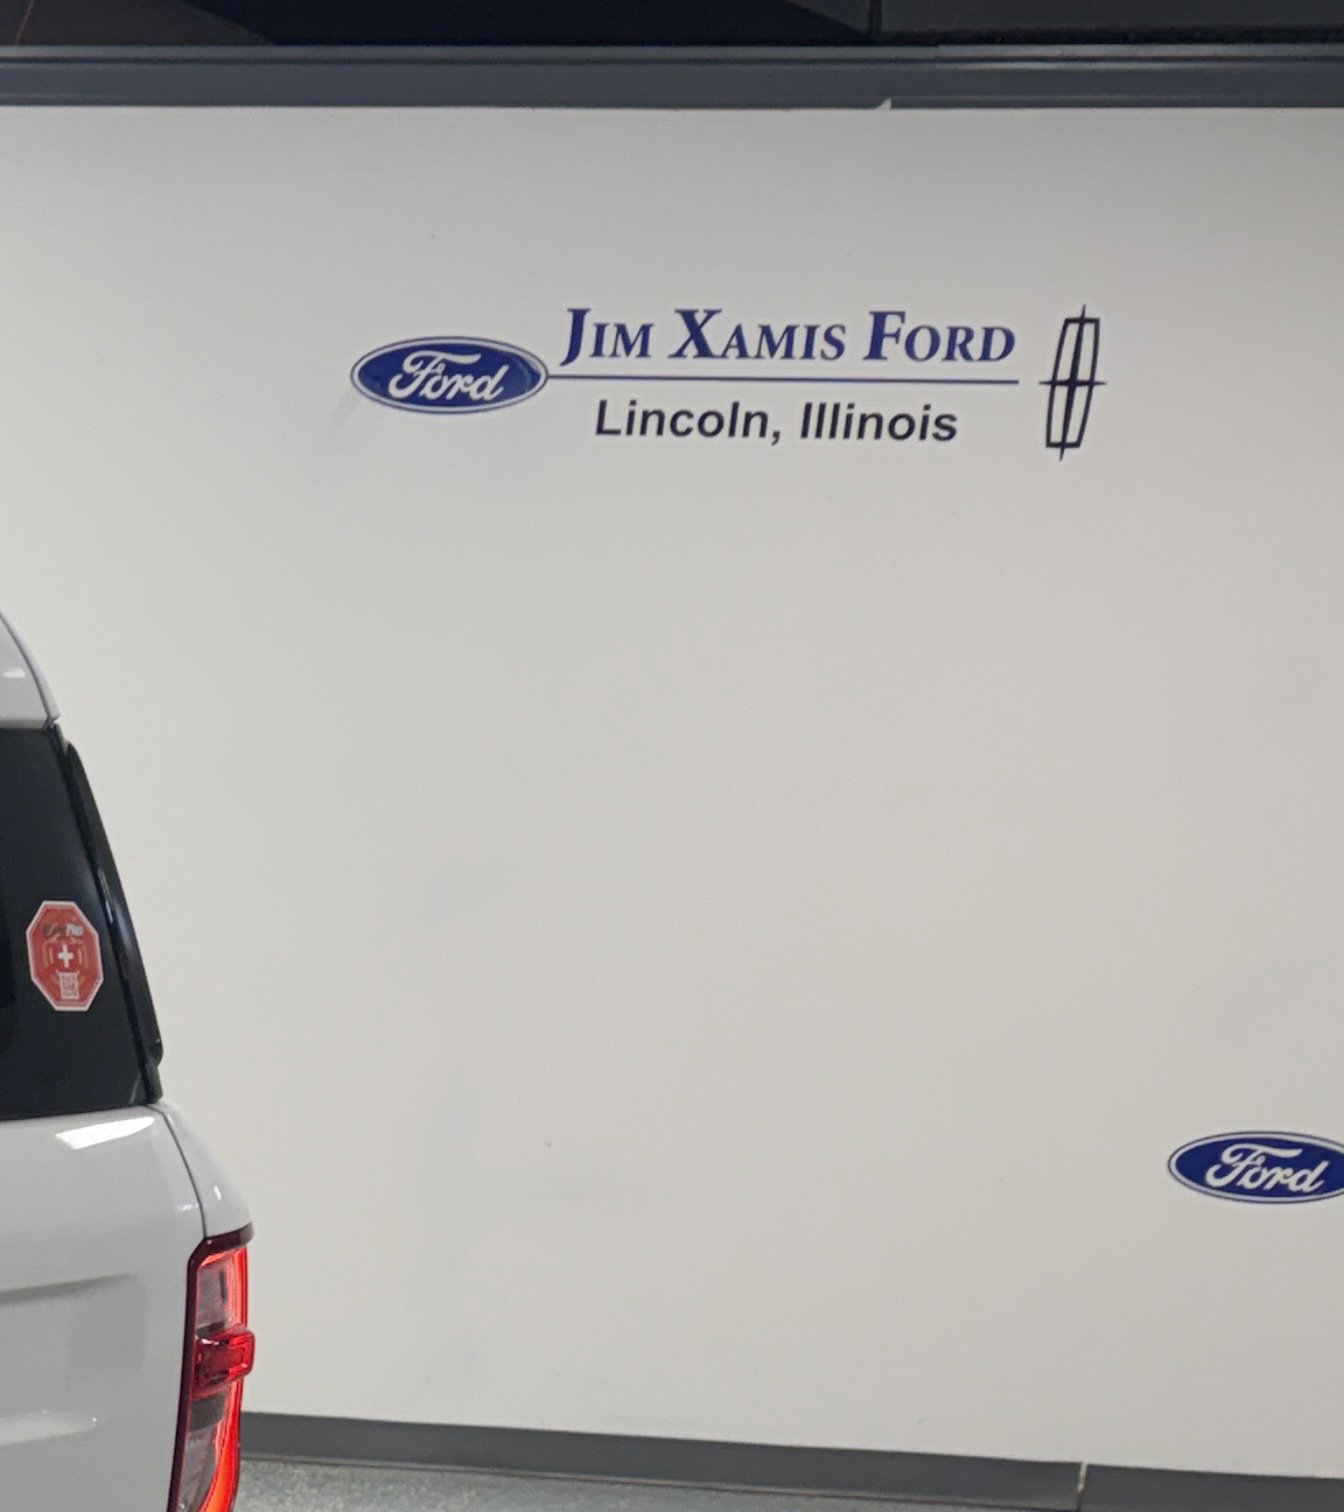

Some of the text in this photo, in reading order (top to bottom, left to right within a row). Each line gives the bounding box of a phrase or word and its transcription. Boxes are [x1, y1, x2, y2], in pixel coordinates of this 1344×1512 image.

[559, 307, 1016, 364] JIM XAMIS FORD
[388, 350, 506, 402] Ford
[595, 399, 959, 445] Lincoln, Illinois
[1205, 1143, 1330, 1193] Ford
